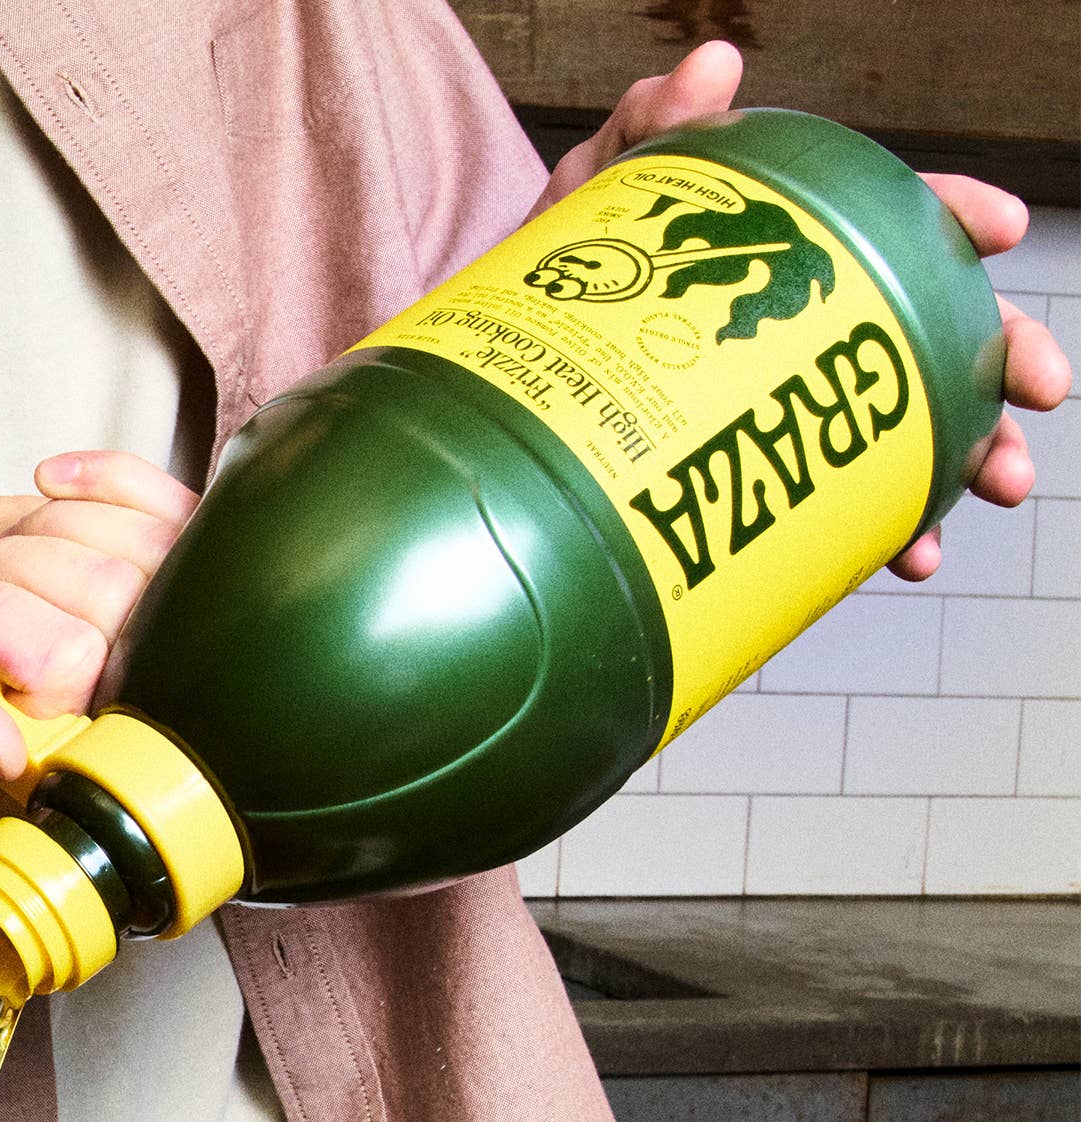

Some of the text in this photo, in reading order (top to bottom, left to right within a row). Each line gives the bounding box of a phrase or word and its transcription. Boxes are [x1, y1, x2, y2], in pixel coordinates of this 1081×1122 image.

[634, 173, 656, 181] OIL
[656, 176, 696, 190] HEAT
[695, 186, 736, 208] HIGH
[505, 307, 523, 319] Oil
[536, 310, 548, 319] as
[525, 317, 558, 336] Pomace
[640, 327, 669, 340] ORIGIN
[561, 336, 587, 356] Olive
[606, 342, 627, 360] heat
[588, 357, 602, 367] of
[596, 348, 612, 362] Use
[460, 347, 552, 409] “Frizzle”
[604, 369, 622, 384] mix
[616, 363, 646, 394] E.V.O.O.
[629, 360, 650, 382] high
[416, 310, 651, 463] High Heat Cooking Oil
[651, 385, 673, 406] your
[624, 387, 663, 429] glorious
[646, 397, 662, 412] our
[662, 415, 679, 432] and
[672, 410, 688, 426] all
[662, 431, 670, 440] A
[588, 442, 617, 478] NEUTRAL
[629, 322, 908, 590] GRAZA
